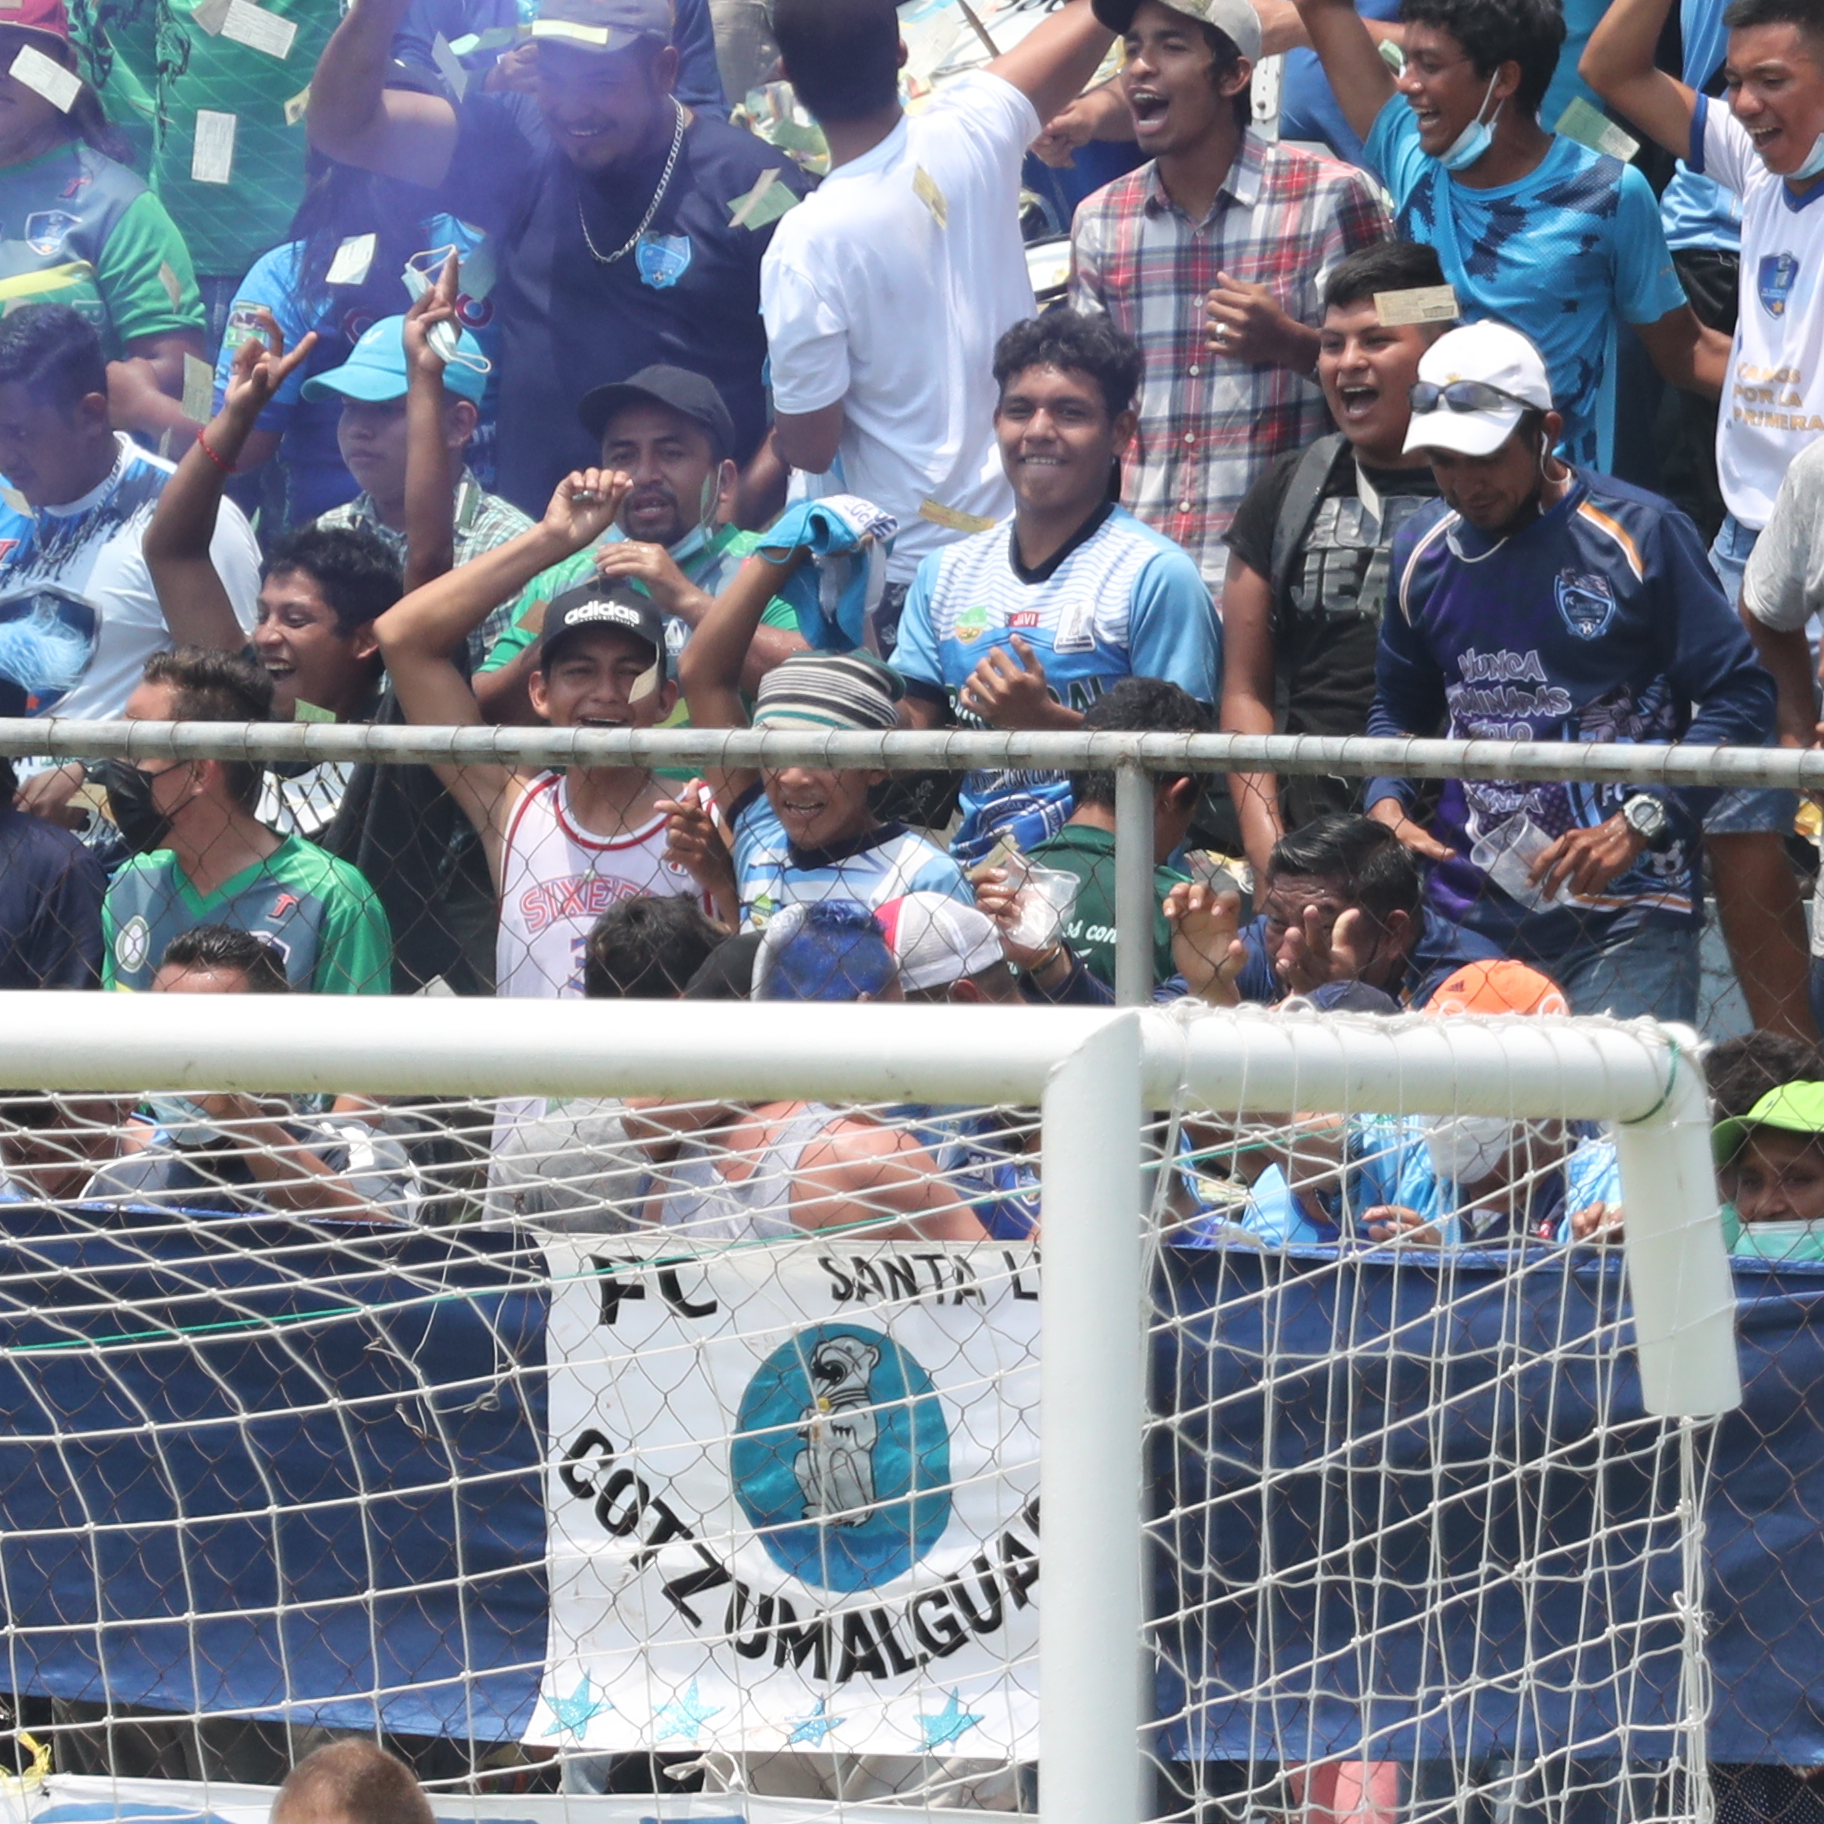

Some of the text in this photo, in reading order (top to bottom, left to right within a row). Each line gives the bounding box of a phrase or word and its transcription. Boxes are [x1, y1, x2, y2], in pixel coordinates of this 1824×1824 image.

[1733, 384, 1804, 409] POR LA
[564, 600, 641, 626] adidas
[1456, 648, 1548, 684] NUNCA
[589, 1252, 719, 1326] FC
[817, 1253, 988, 1307] SANTA
